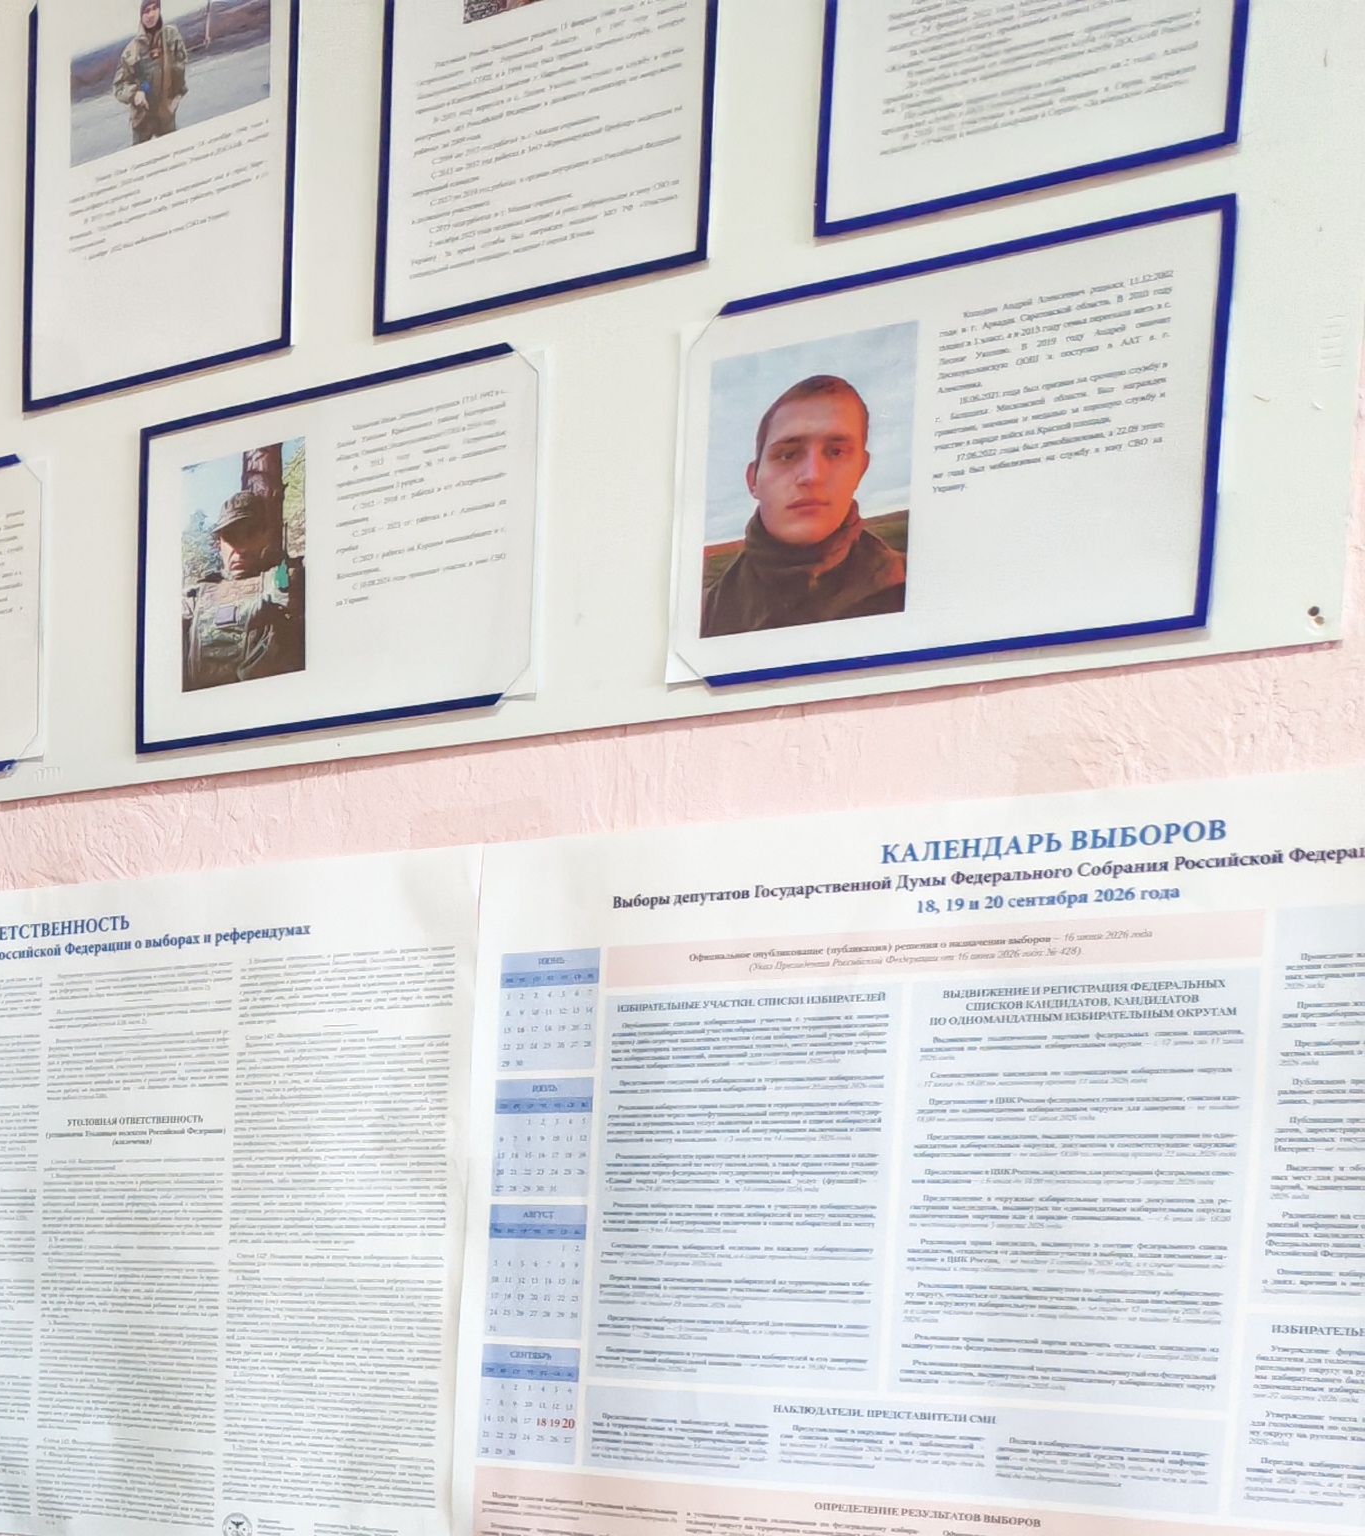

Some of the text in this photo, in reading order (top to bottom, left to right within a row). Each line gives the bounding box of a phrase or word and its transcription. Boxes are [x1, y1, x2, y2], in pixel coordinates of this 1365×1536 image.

[879, 818, 1227, 865] КАЛЕНДАРЬ ВЫБОРОВ
[612, 893, 671, 910] Выборы
[673, 888, 751, 908] депутатов
[754, 876, 891, 901] Государственной
[894, 873, 947, 893] Думы
[950, 865, 1073, 888] Федерального
[1077, 860, 1169, 879] Собрания
[1174, 849, 1285, 871] Российской
[916, 887, 1181, 915] 18, 19 и 20 сентября 2026 года
[64, 940, 132, 957] Федерации
[134, 940, 142, 949] о
[145, 933, 200, 951] выборах
[203, 933, 212, 944] и
[214, 923, 312, 946] референдумах
[942, 986, 1031, 999] ВЫДВИЖЕНИЕ
[1042, 982, 1128, 996] РЕГИСТРАЦИЯ
[1129, 978, 1227, 992] ФЕДЕРАЛЬНЫХ
[617, 1000, 702, 1013] ИЗБИРАТЕЛЬНЫЕ
[757, 994, 805, 1008] СПИСКИ
[806, 990, 887, 1006] ИЗБИРАТЕЛЕЙ
[965, 999, 1024, 1012] СПИСКОВ
[1113, 993, 1200, 1007] КАНДИДАТОВ
[929, 1005, 1237, 1026] ПО ОДНОМАНДАТНЫМ ИЗБИРАТЕЛЬНЫМ ОКРУГАМ
[66, 1114, 204, 1127] УГОЛОВНАЯ ОТВЕТСТВЕННОСТЬ
[535, 1417, 547, 1428] 18
[549, 1417, 561, 1428] 19
[561, 1418, 576, 1429] 20
[772, 1404, 997, 1425] НАБЛЮДАТЕЛИ. ПРЕДСТАВИТЕЛИ СМИ
[813, 1501, 1042, 1528] ОПРЕДЕЛЕНИЕ РЕЗУЛЬТАТОВ ВЫБОРОВ
